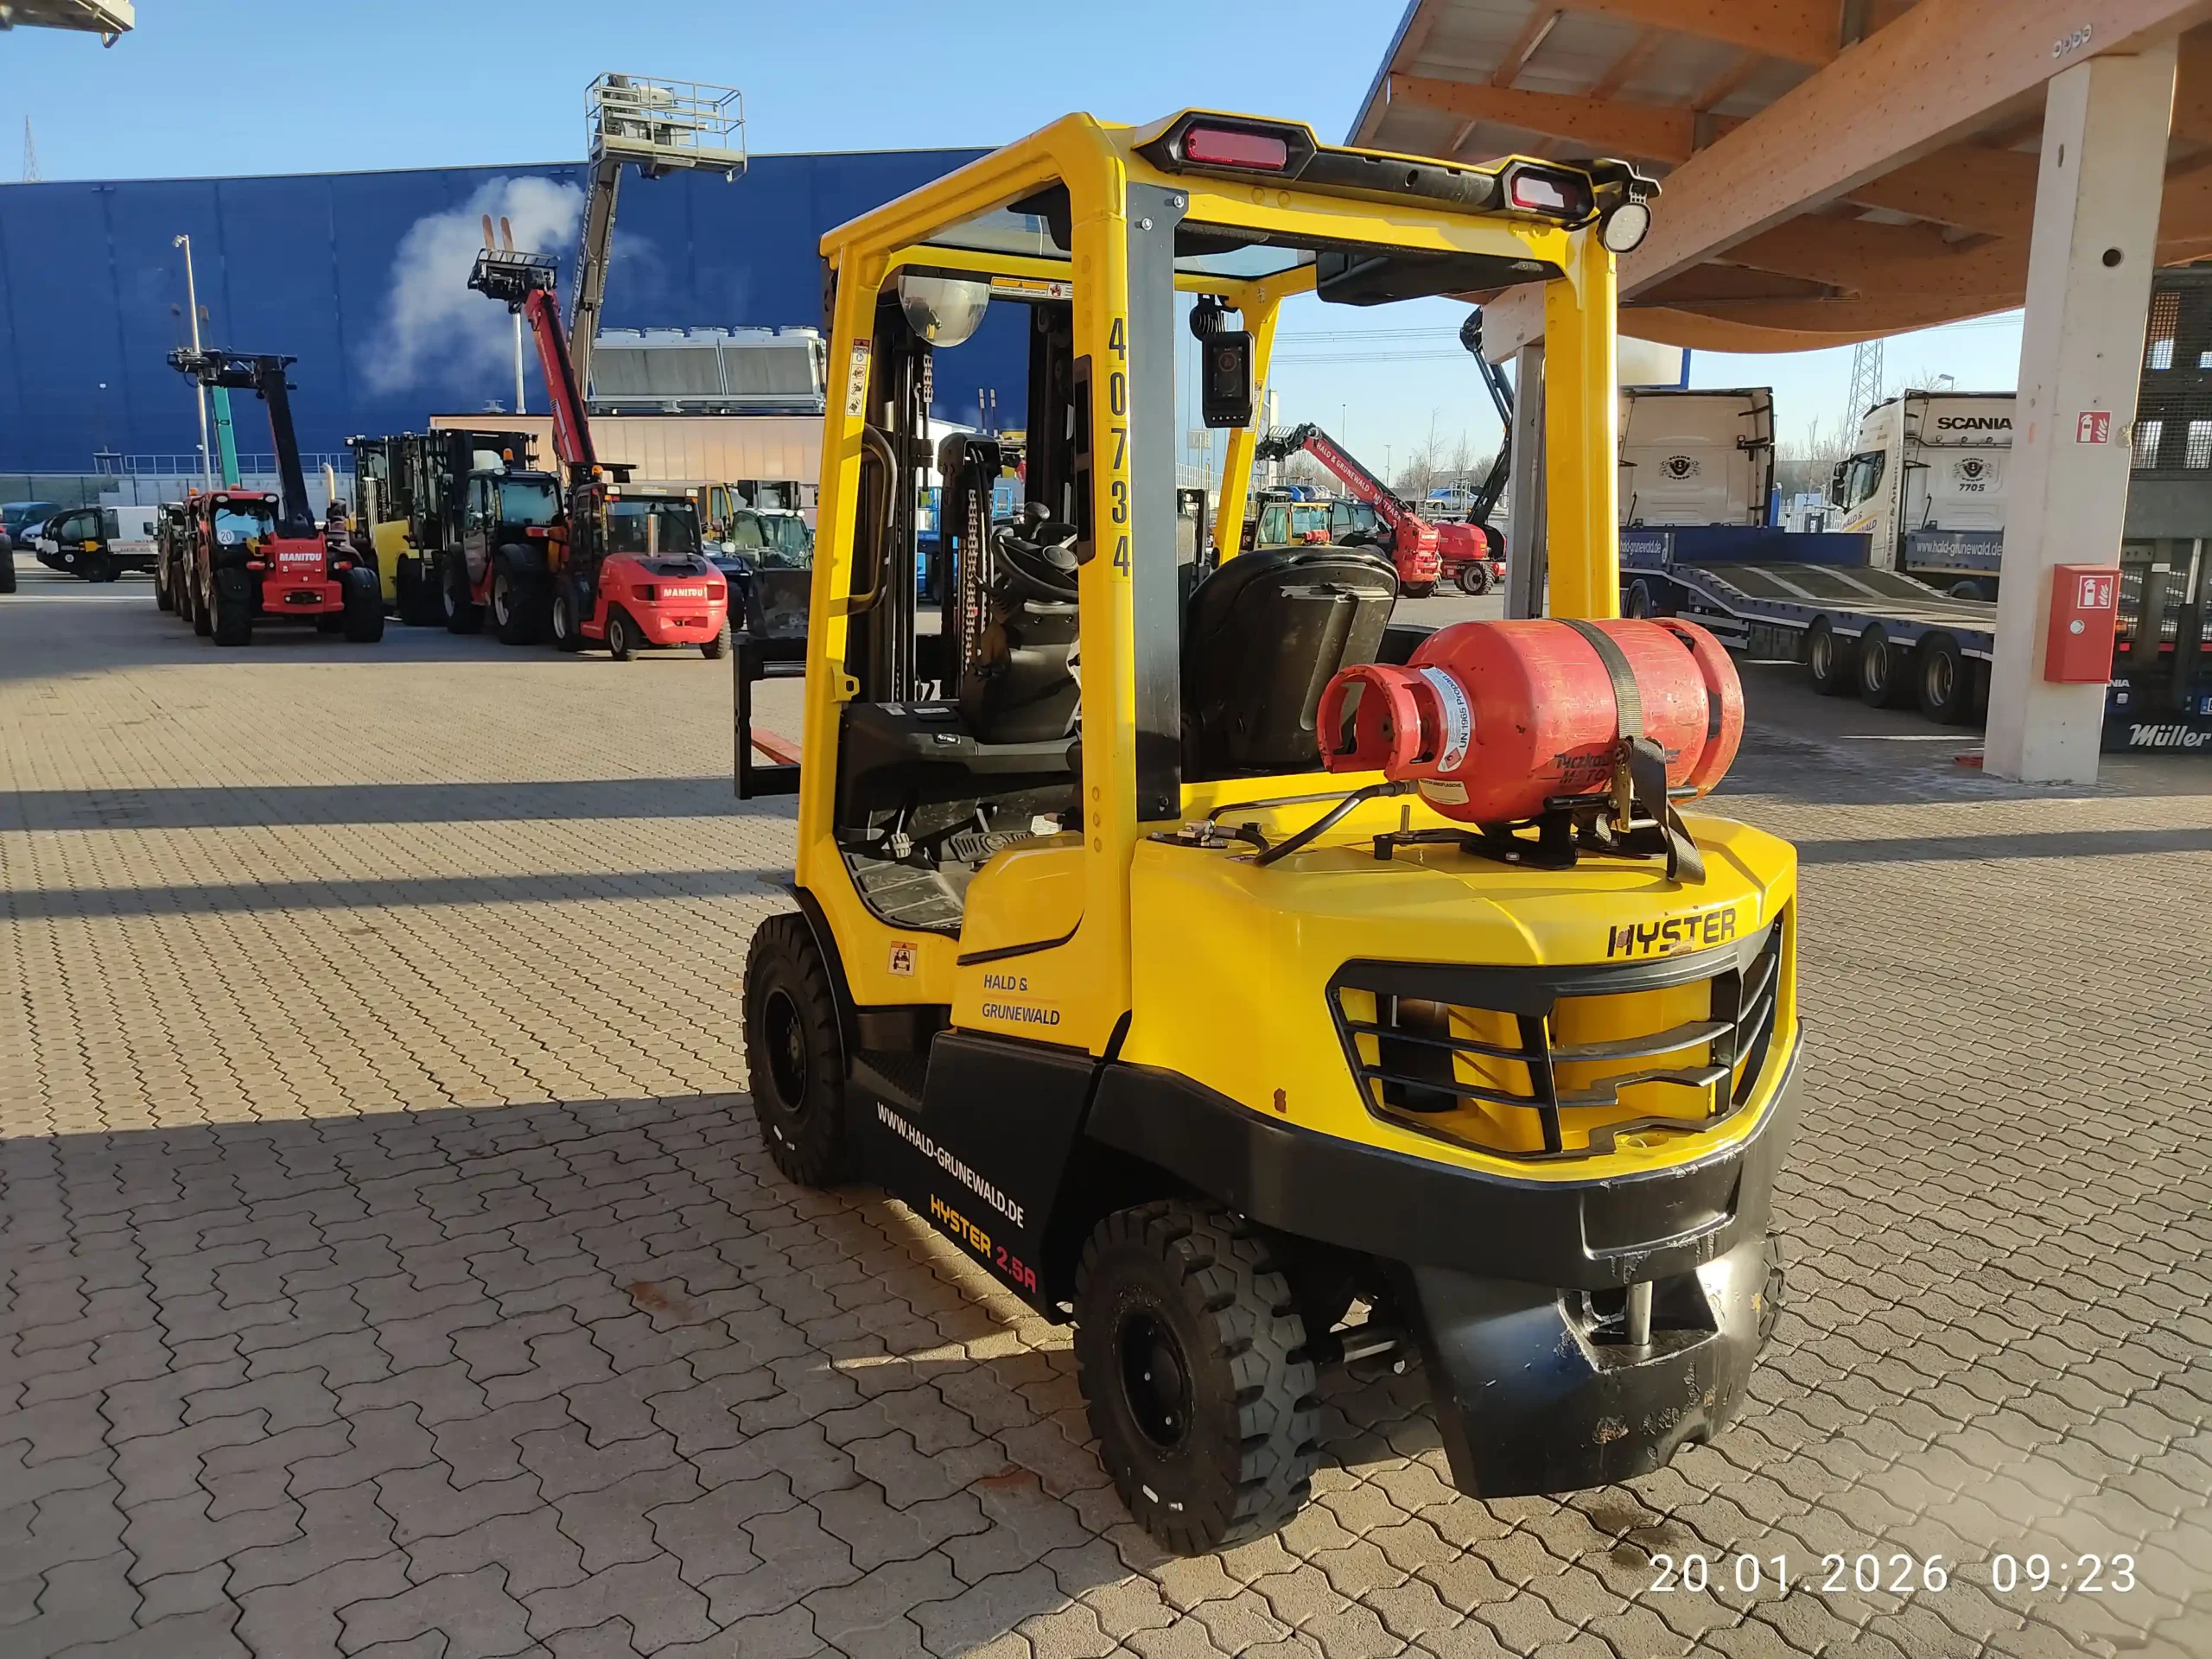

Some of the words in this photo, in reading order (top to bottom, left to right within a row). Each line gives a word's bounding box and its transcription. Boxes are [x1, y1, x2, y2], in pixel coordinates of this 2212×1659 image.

[1936, 417, 2013, 430] SCANIA
[1316, 442, 1332, 459] HALD
[1336, 459, 1370, 492] GRUNEWALD
[1373, 493, 1402, 521] MITPARK
[1959, 483, 1986, 493] 770S
[220, 531, 232, 542] 20
[1916, 540, 2003, 556] www.hald-grunewald.de
[279, 553, 322, 562] MANITOU
[664, 588, 703, 597] MANITOU
[1442, 675, 1465, 706] Propan
[2107, 679, 2131, 688] NIA
[1459, 709, 1469, 730] 1965
[1459, 733, 1469, 748] UN
[2129, 723, 2212, 747] Müller
[1607, 908, 1736, 957] HYSTER
[983, 974, 1016, 990] HALD
[1019, 977, 1028, 991] &
[982, 1003, 1060, 1026] GRUNEWALD
[877, 1101, 1025, 1229] WWW.HALD-GRUNEWALD.DE
[931, 1193, 991, 1259] HYSTER
